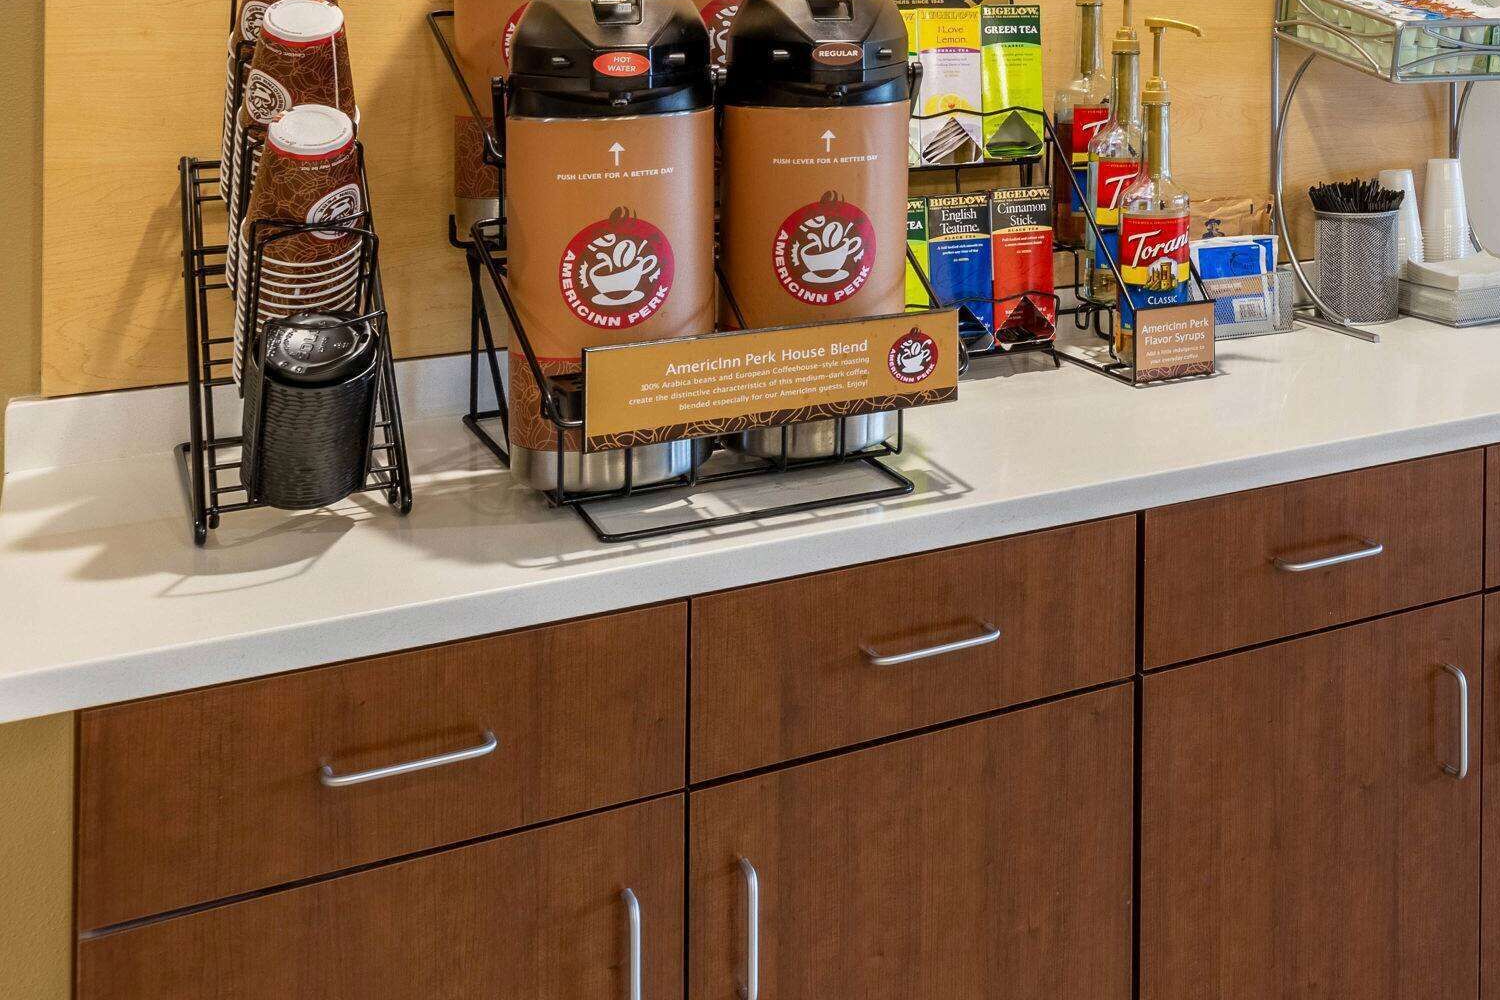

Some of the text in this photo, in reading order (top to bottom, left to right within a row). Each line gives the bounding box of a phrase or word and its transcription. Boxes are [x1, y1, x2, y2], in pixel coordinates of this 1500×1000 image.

[984, 25, 1038, 34] GREEN TEA
[631, 169, 659, 177] BETTER
[941, 208, 977, 223] English
[997, 202, 1047, 214] Cinnamon
[1128, 225, 1190, 269] Torani
[775, 229, 870, 303] AMERICINN PERK
[561, 249, 669, 326] AMERICINN PERK
[1147, 295, 1178, 305] CLASSIC
[1189, 316, 1209, 329] Perk
[1144, 331, 1206, 346] Flavor Syrups
[665, 339, 868, 376] AmericInn Perk House Blend
[640, 356, 870, 392] 100% Arabica beans and European Coffeehouse-style roasting
[628, 396, 654, 406] create
[655, 393, 669, 402] the
[670, 388, 711, 400] distinctive
[712, 380, 767, 394] characteristics
[779, 376, 793, 385] this
[795, 371, 845, 383] medium-dark
[679, 400, 711, 411] blended
[712, 394, 750, 407] especially
[751, 393, 763, 401] for
[847, 379, 869, 389] Enjoy!
